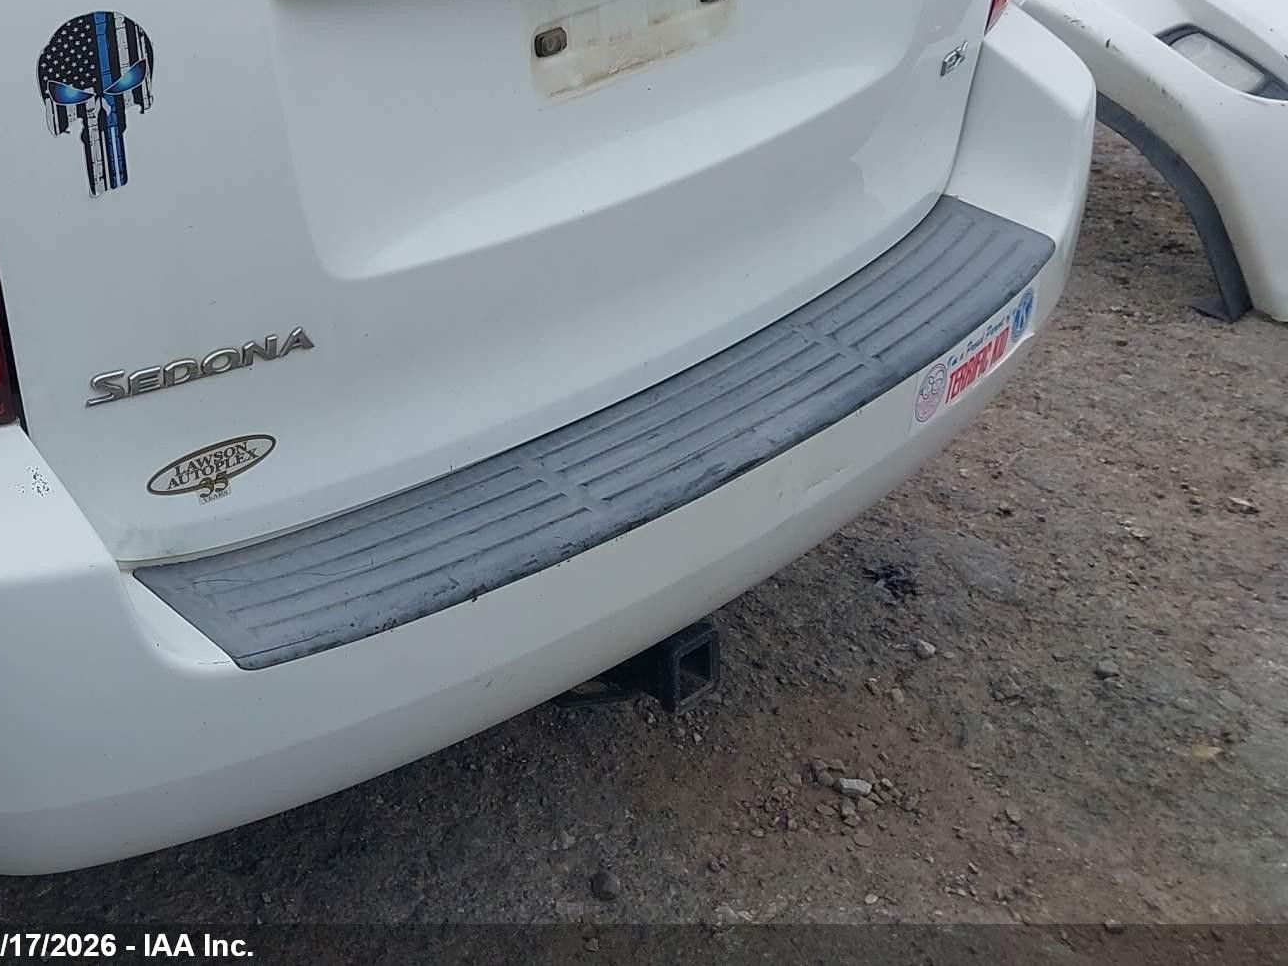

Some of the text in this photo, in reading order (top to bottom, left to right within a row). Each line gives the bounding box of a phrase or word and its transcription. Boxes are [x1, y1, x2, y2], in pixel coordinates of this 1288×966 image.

[940, 40, 968, 77] EX
[85, 326, 316, 408] SEDONA
[166, 447, 260, 490] AUTOPLEX
[174, 441, 248, 477] LAWSON
[199, 471, 229, 498] 35
